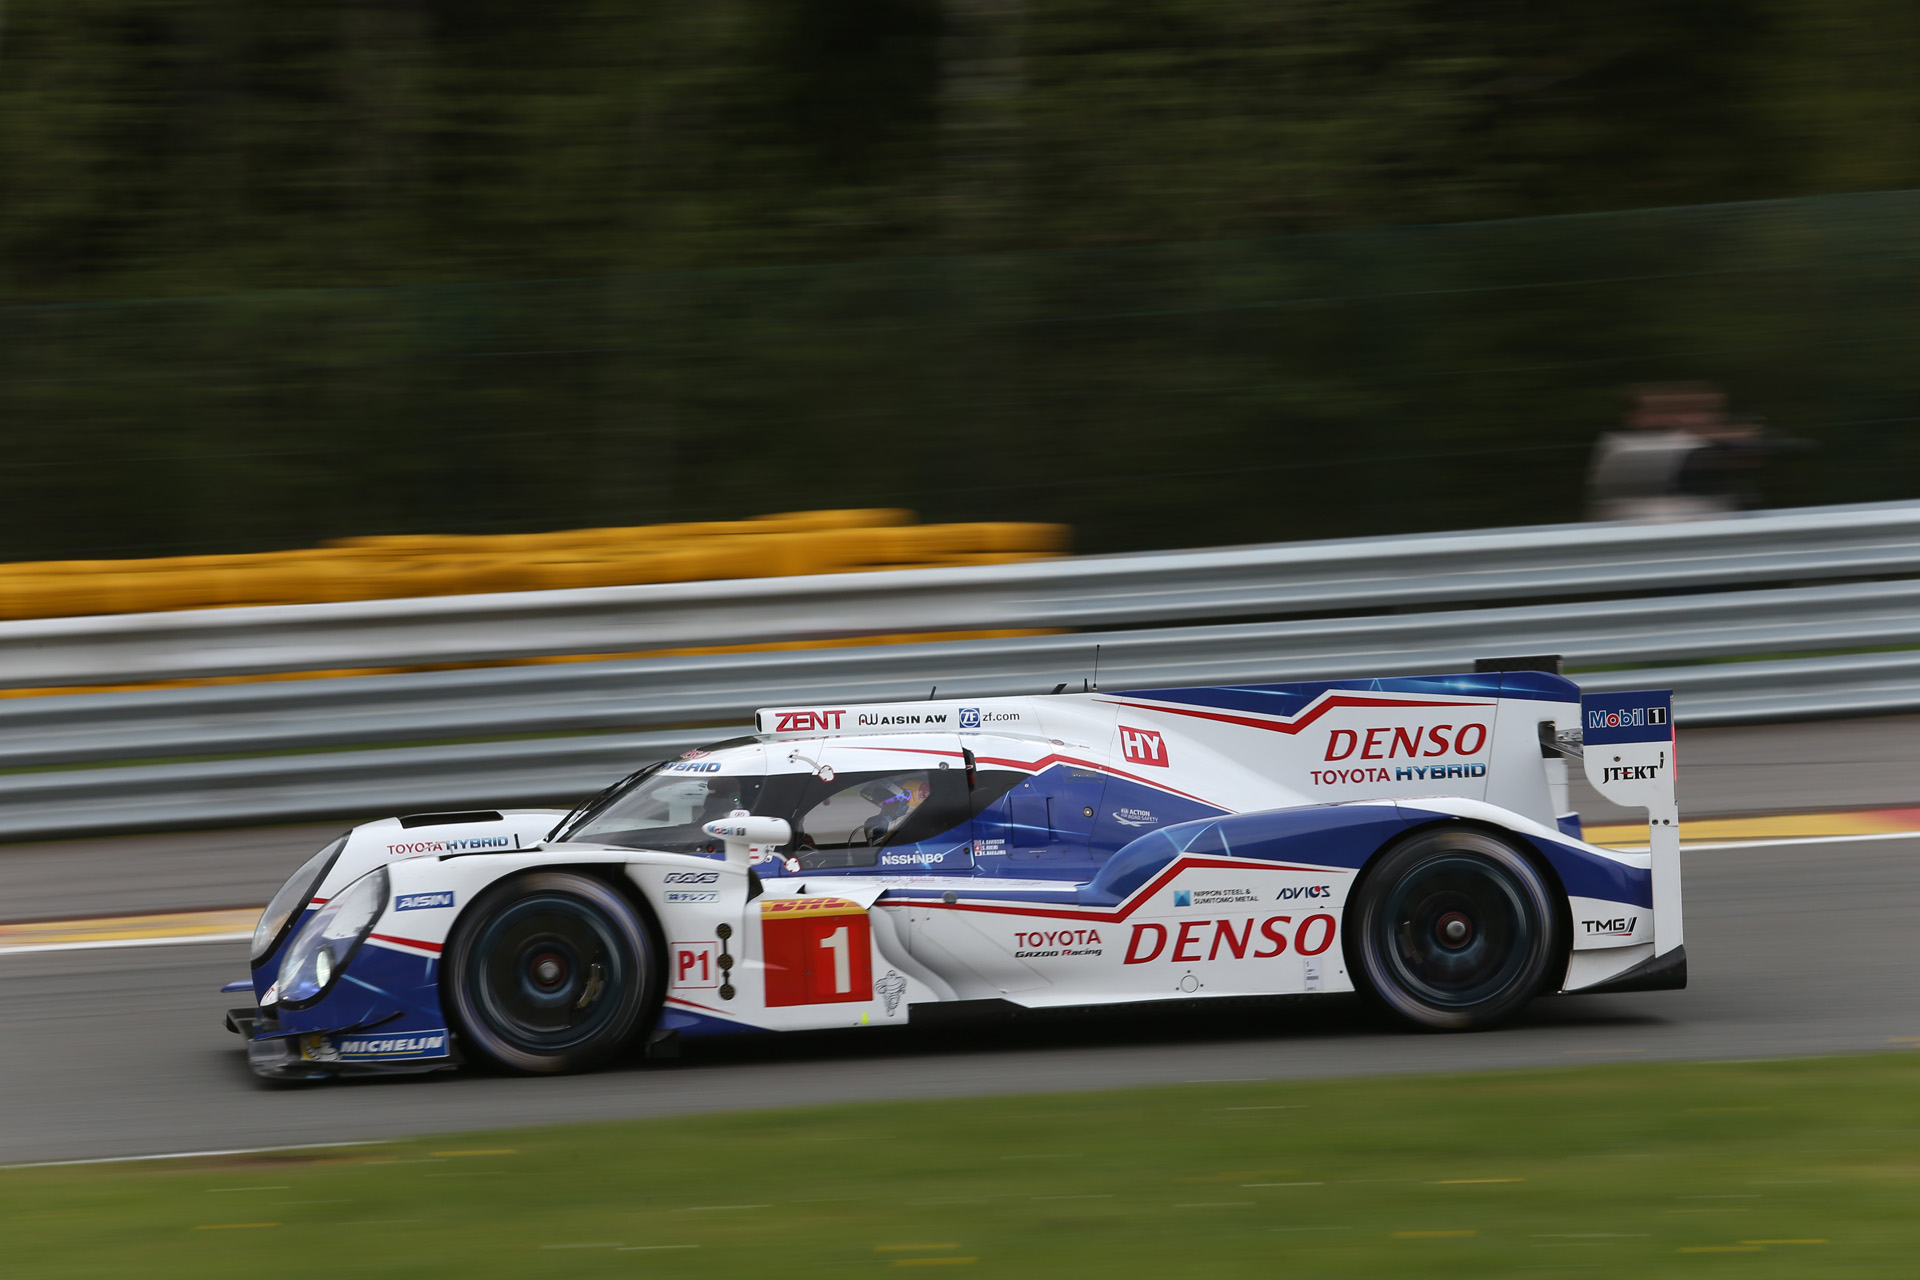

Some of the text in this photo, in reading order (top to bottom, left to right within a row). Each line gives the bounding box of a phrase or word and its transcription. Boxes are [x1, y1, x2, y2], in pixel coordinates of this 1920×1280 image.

[775, 709, 847, 732] ZENT
[881, 715, 921, 725] AISIN
[925, 714, 948, 723] AW
[961, 711, 1020, 723] ZF zf.com
[1588, 707, 1645, 729] Mobil
[1123, 731, 1160, 760] HY
[1324, 723, 1487, 761] DENSO
[1310, 762, 1487, 785] TOYOTA HYBRID
[1602, 765, 1659, 784] JTEKT
[1129, 809, 1151, 817] ACTION
[707, 825, 734, 836] Mobil
[387, 836, 509, 855] TOYOTA HYBRID
[881, 851, 944, 866] NISSHINBO
[663, 872, 719, 883] RAYS
[1194, 895, 1259, 905] SUMITOMO METAL
[1223, 888, 1244, 896] STEEL
[1276, 885, 1331, 900] ADVICS
[397, 893, 452, 909] AISIN
[770, 898, 846, 912] DHL
[1581, 918, 1626, 933] TMG
[1014, 929, 1102, 947] TOYOTA
[1123, 913, 1337, 965] DENSO
[820, 926, 851, 994] 1
[1014, 948, 1103, 958] GAZOO Racing
[678, 950, 709, 981] P1
[341, 1036, 445, 1053] MICHELIN
